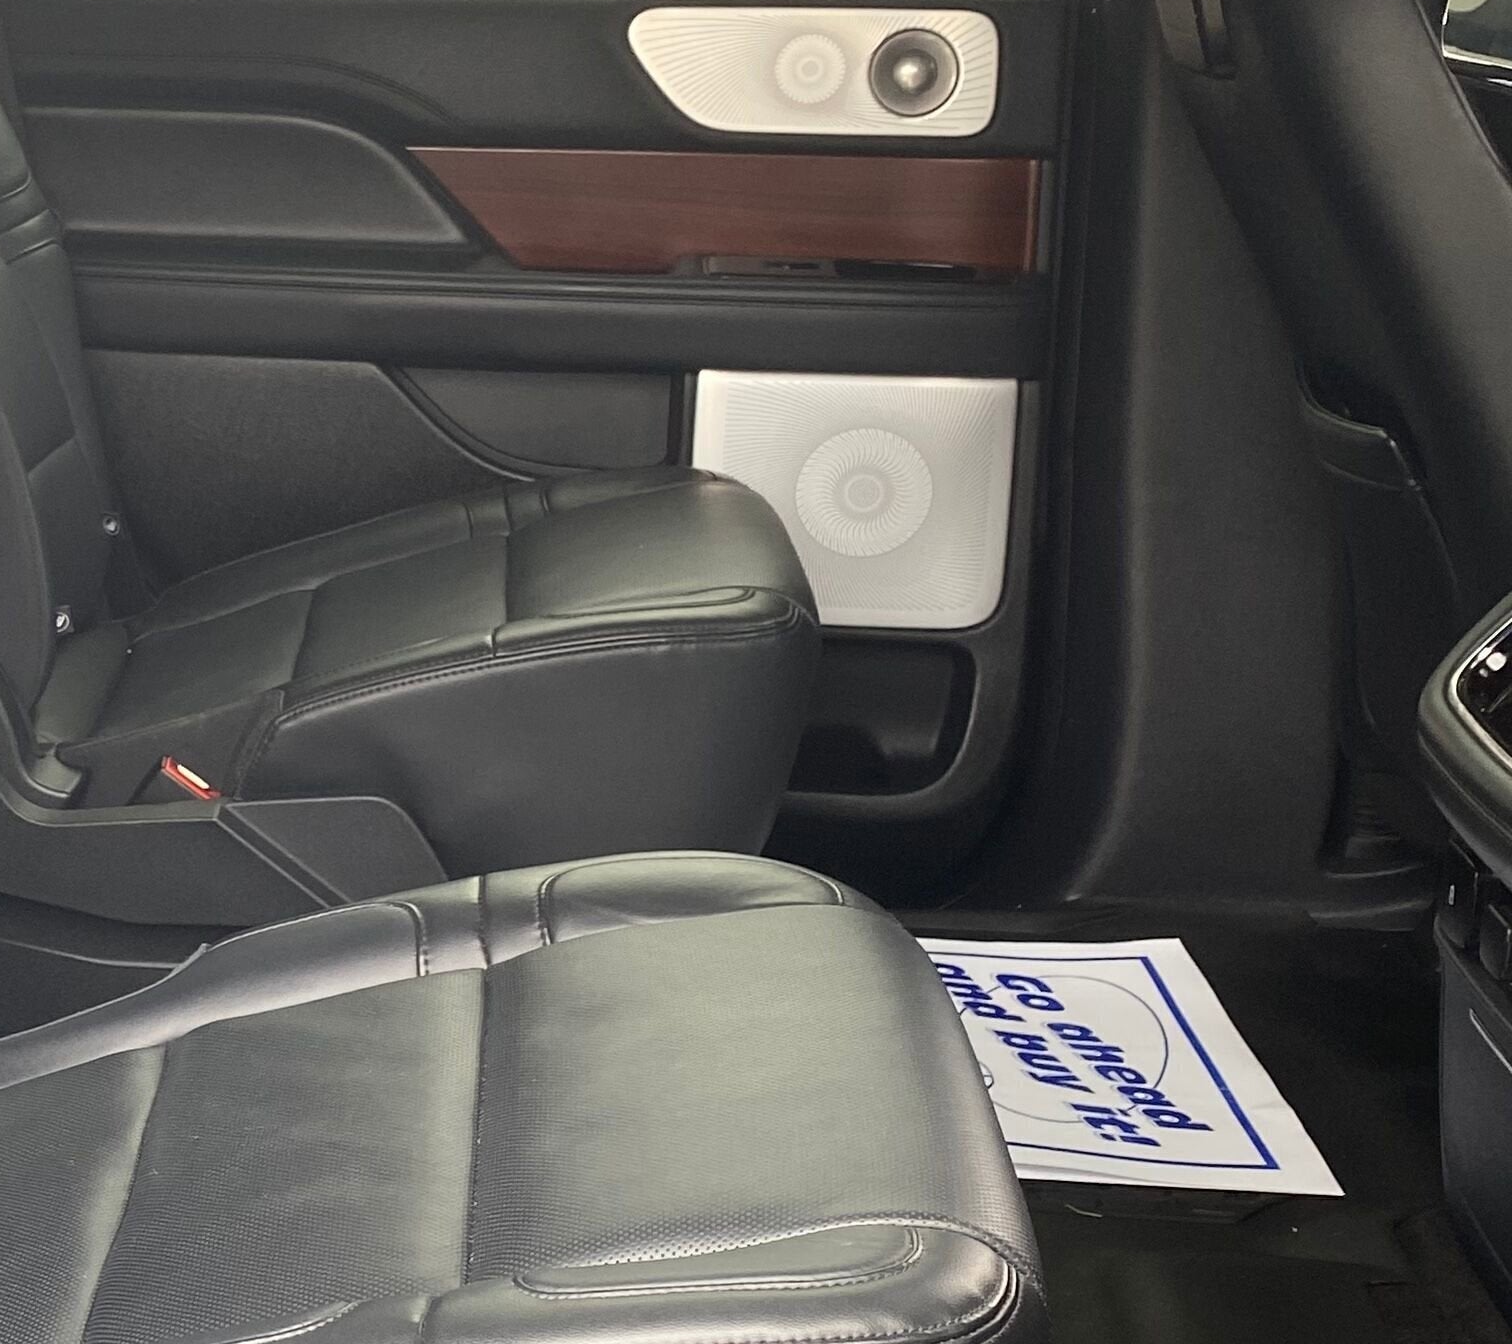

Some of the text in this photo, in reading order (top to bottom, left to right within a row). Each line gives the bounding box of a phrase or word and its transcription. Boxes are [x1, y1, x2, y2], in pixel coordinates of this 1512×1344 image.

[933, 961, 1026, 1023] and
[990, 1028, 1095, 1095] buy
[994, 972, 1215, 1133] Go ahead
